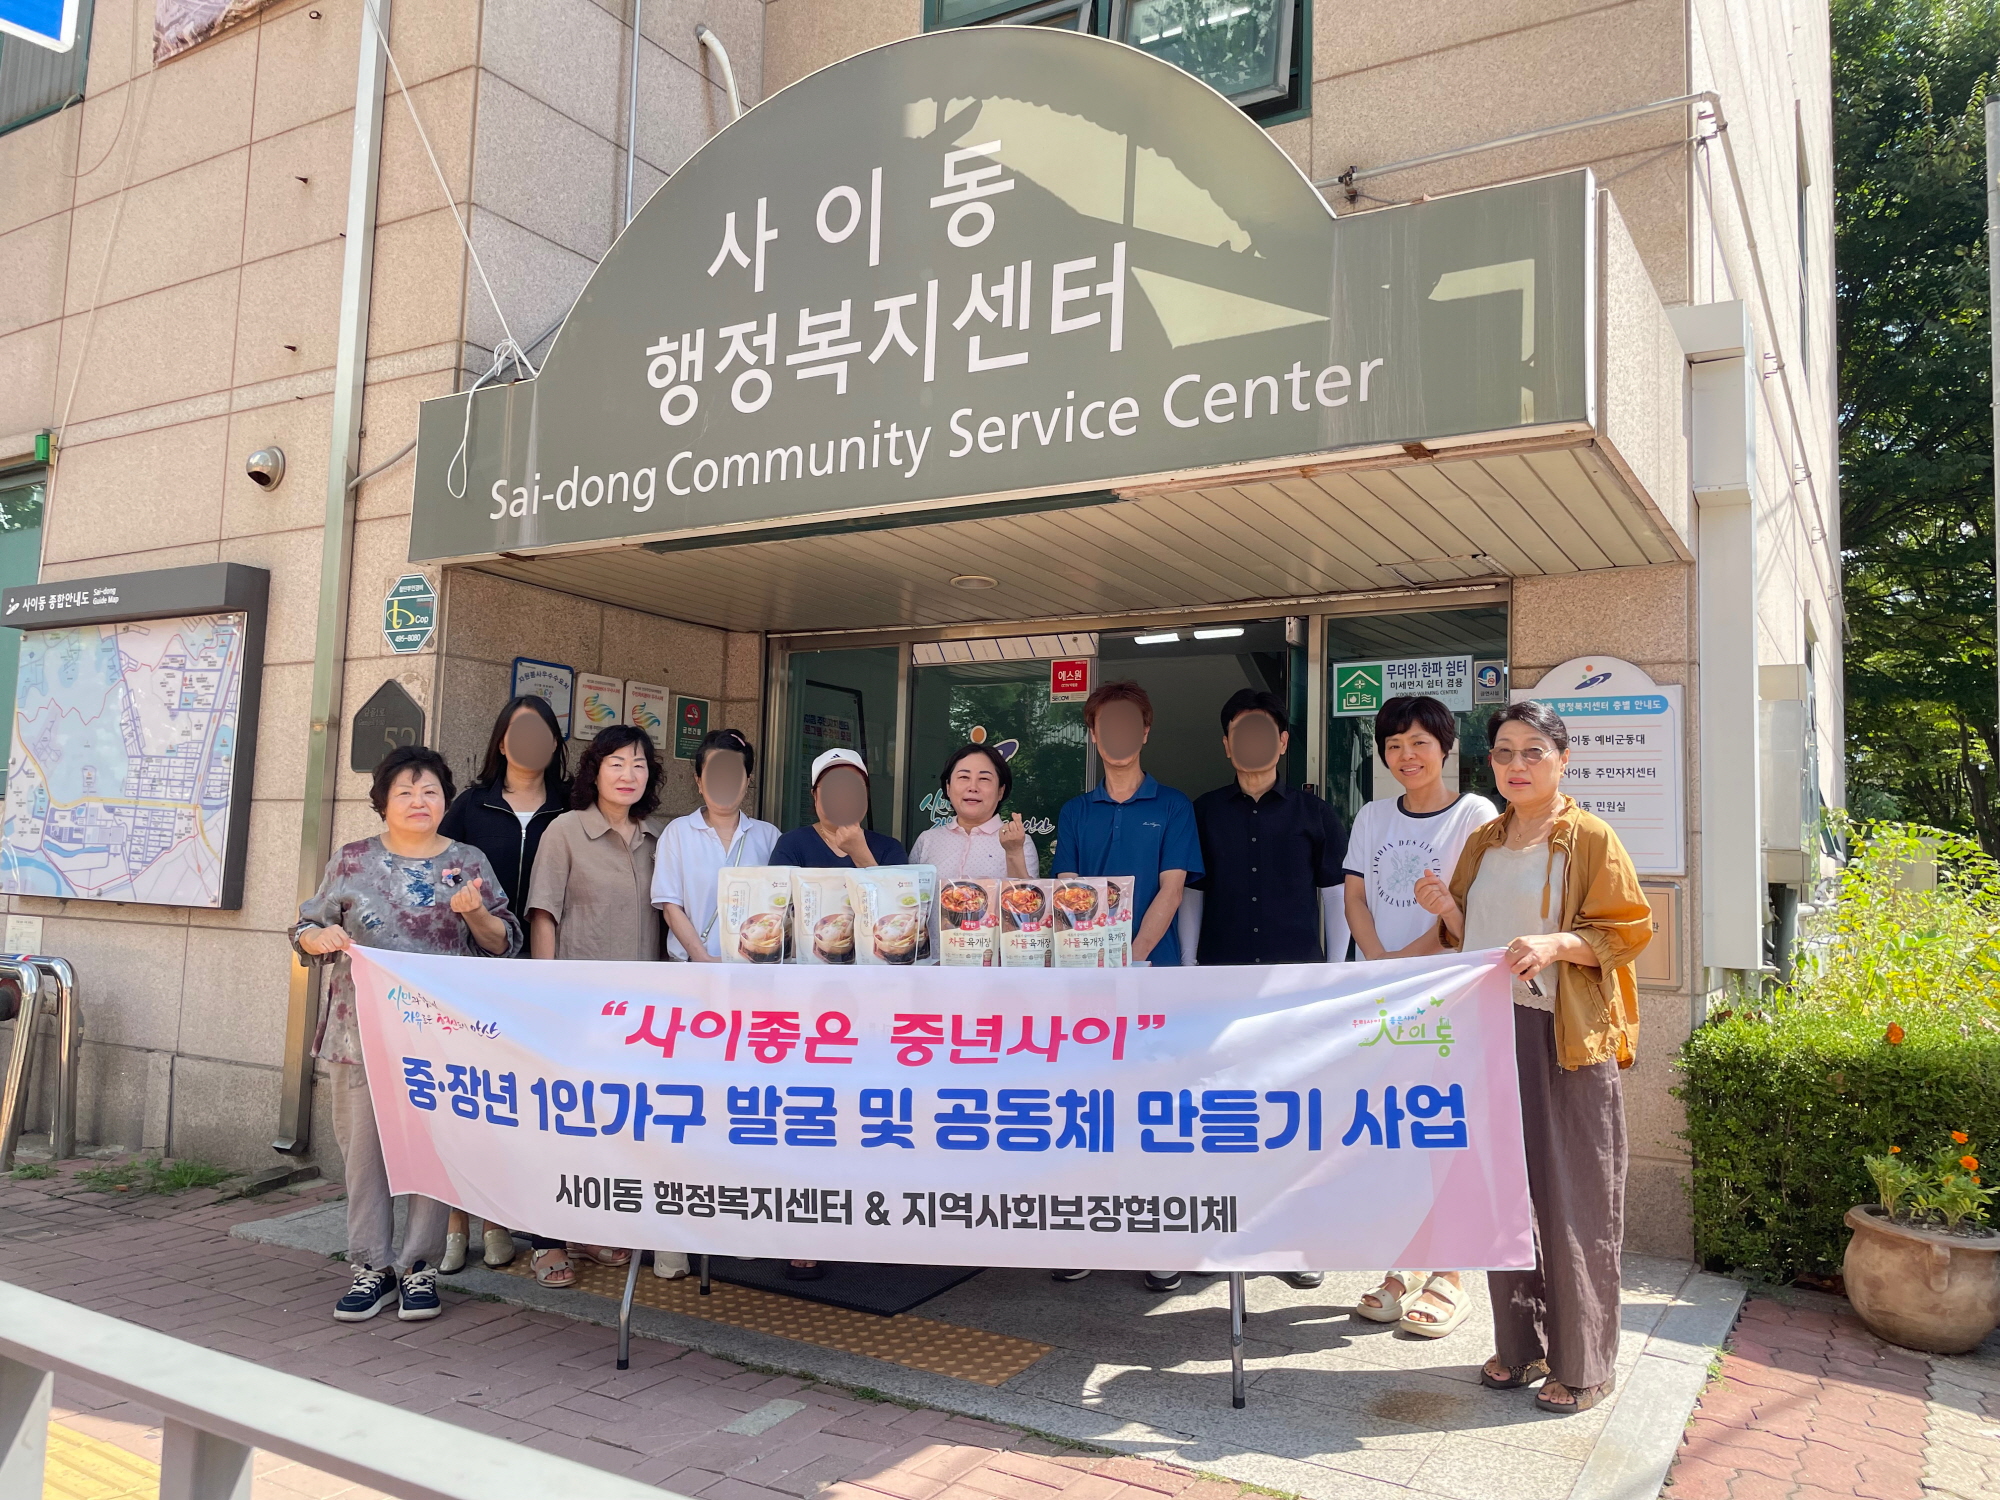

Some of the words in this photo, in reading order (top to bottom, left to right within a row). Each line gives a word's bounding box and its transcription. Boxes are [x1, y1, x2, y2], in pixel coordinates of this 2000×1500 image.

[707, 139, 1015, 293] 사이동
[645, 241, 1126, 425] 행정복지센터
[489, 465, 657, 520] Sai-dong
[665, 419, 932, 496] Community
[949, 390, 1140, 458] Service
[1162, 357, 1384, 429] Center
[92, 597, 107, 605] Guide
[108, 596, 119, 604] Map
[93, 587, 117, 596] Sai-dong
[22, 596, 46, 612] 사이동
[48, 591, 90, 610] 종합안내도
[1058, 670, 1082, 681] 에스원
[1386, 661, 1442, 680] 무더위·한파
[1445, 660, 1467, 676] 쉼터
[1390, 680, 1423, 690] 미세먼지
[1427, 678, 1443, 689] 쉼터
[1446, 678, 1463, 688] 겸용
[1558, 701, 1609, 712] 행정복지센터
[1612, 700, 1631, 711] 층별
[1634, 699, 1662, 710] 안내도
[1594, 734, 1646, 745] 예비군동대
[1595, 767, 1656, 778] 주민자치센터
[1596, 801, 1626, 812] 민원실
[1398, 839, 1417, 847] DES
[731, 890, 740, 926] 고려삼계탕
[470, 1020, 501, 1039] 안산
[600, 1000, 860, 1065] “사이좋은
[890, 1012, 1167, 1066] 중년사이”
[1358, 1009, 1455, 1058] 사이동
[401, 1056, 519, 1128] 중·장년
[530, 1077, 707, 1144] 1인가구
[728, 1084, 838, 1148] 발굴
[858, 1087, 915, 1152] 및
[934, 1087, 1115, 1154] 공동체
[1137, 1087, 1321, 1154] 만들기
[1341, 1082, 1469, 1152] 사업
[556, 1173, 644, 1214] 사이동
[653, 1179, 853, 1226] 행정복지센터
[864, 1190, 892, 1226] &
[901, 1191, 1238, 1234] 지역사회보장협의체
